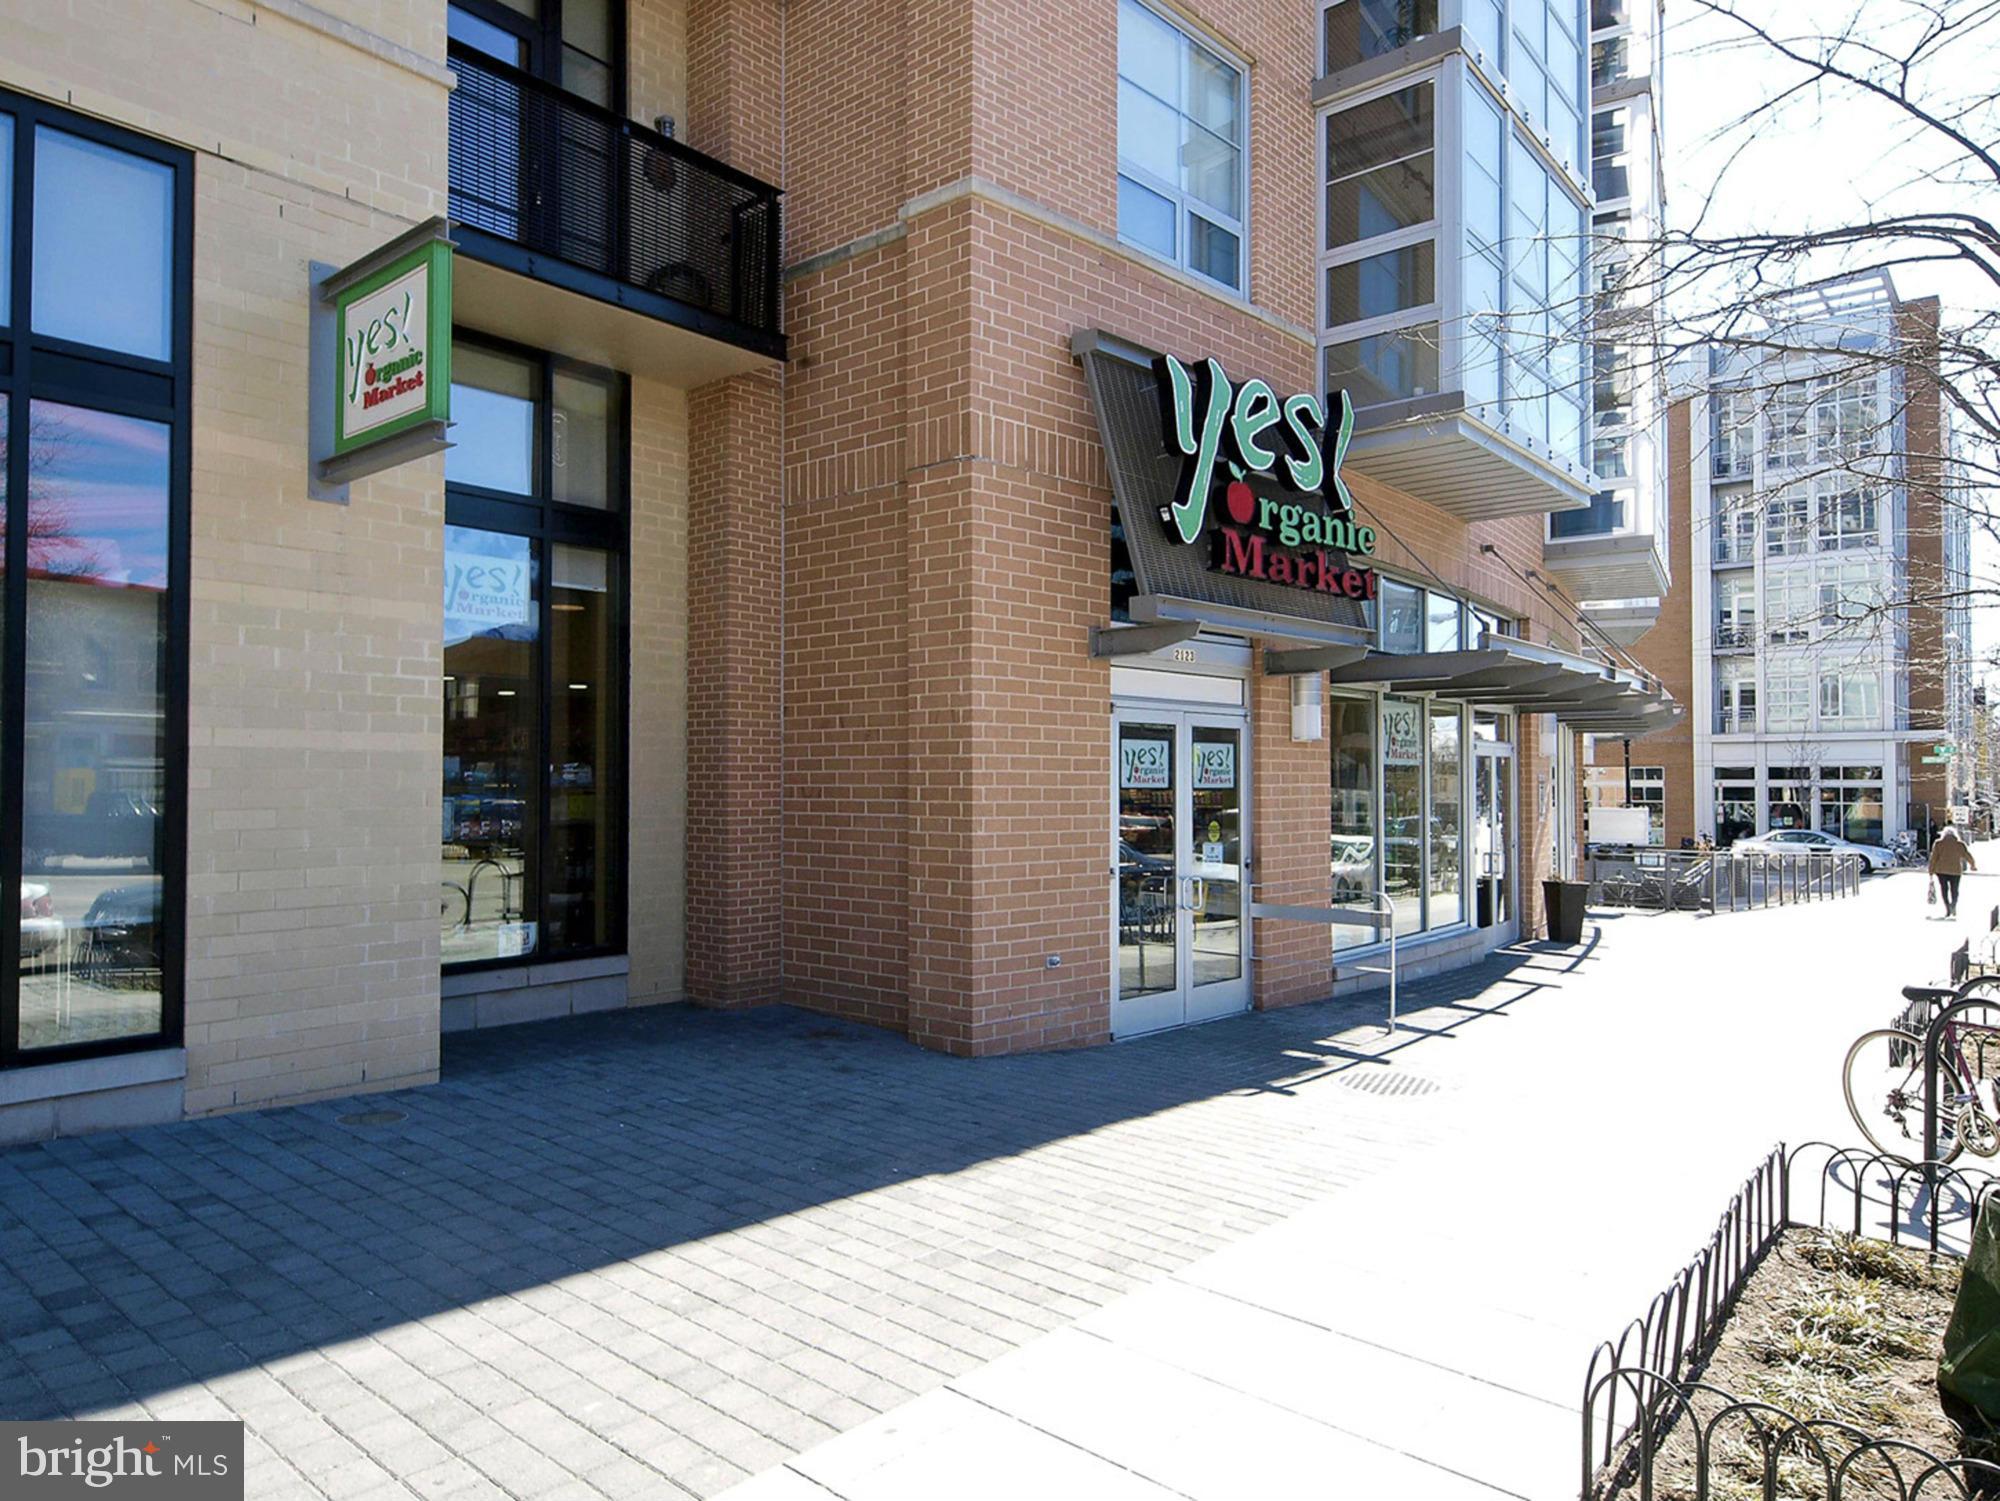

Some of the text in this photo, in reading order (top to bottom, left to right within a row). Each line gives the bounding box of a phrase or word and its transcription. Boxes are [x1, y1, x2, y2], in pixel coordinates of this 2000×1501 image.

[347, 291, 411, 404] yes!
[362, 370, 424, 410] Market
[1164, 353, 1355, 544] yes!
[1221, 527, 1376, 600] Market
[456, 602, 522, 619] Market
[1174, 649, 1194, 662] 2123
[1133, 774, 1165, 785] Market
[1203, 775, 1231, 785] Market
